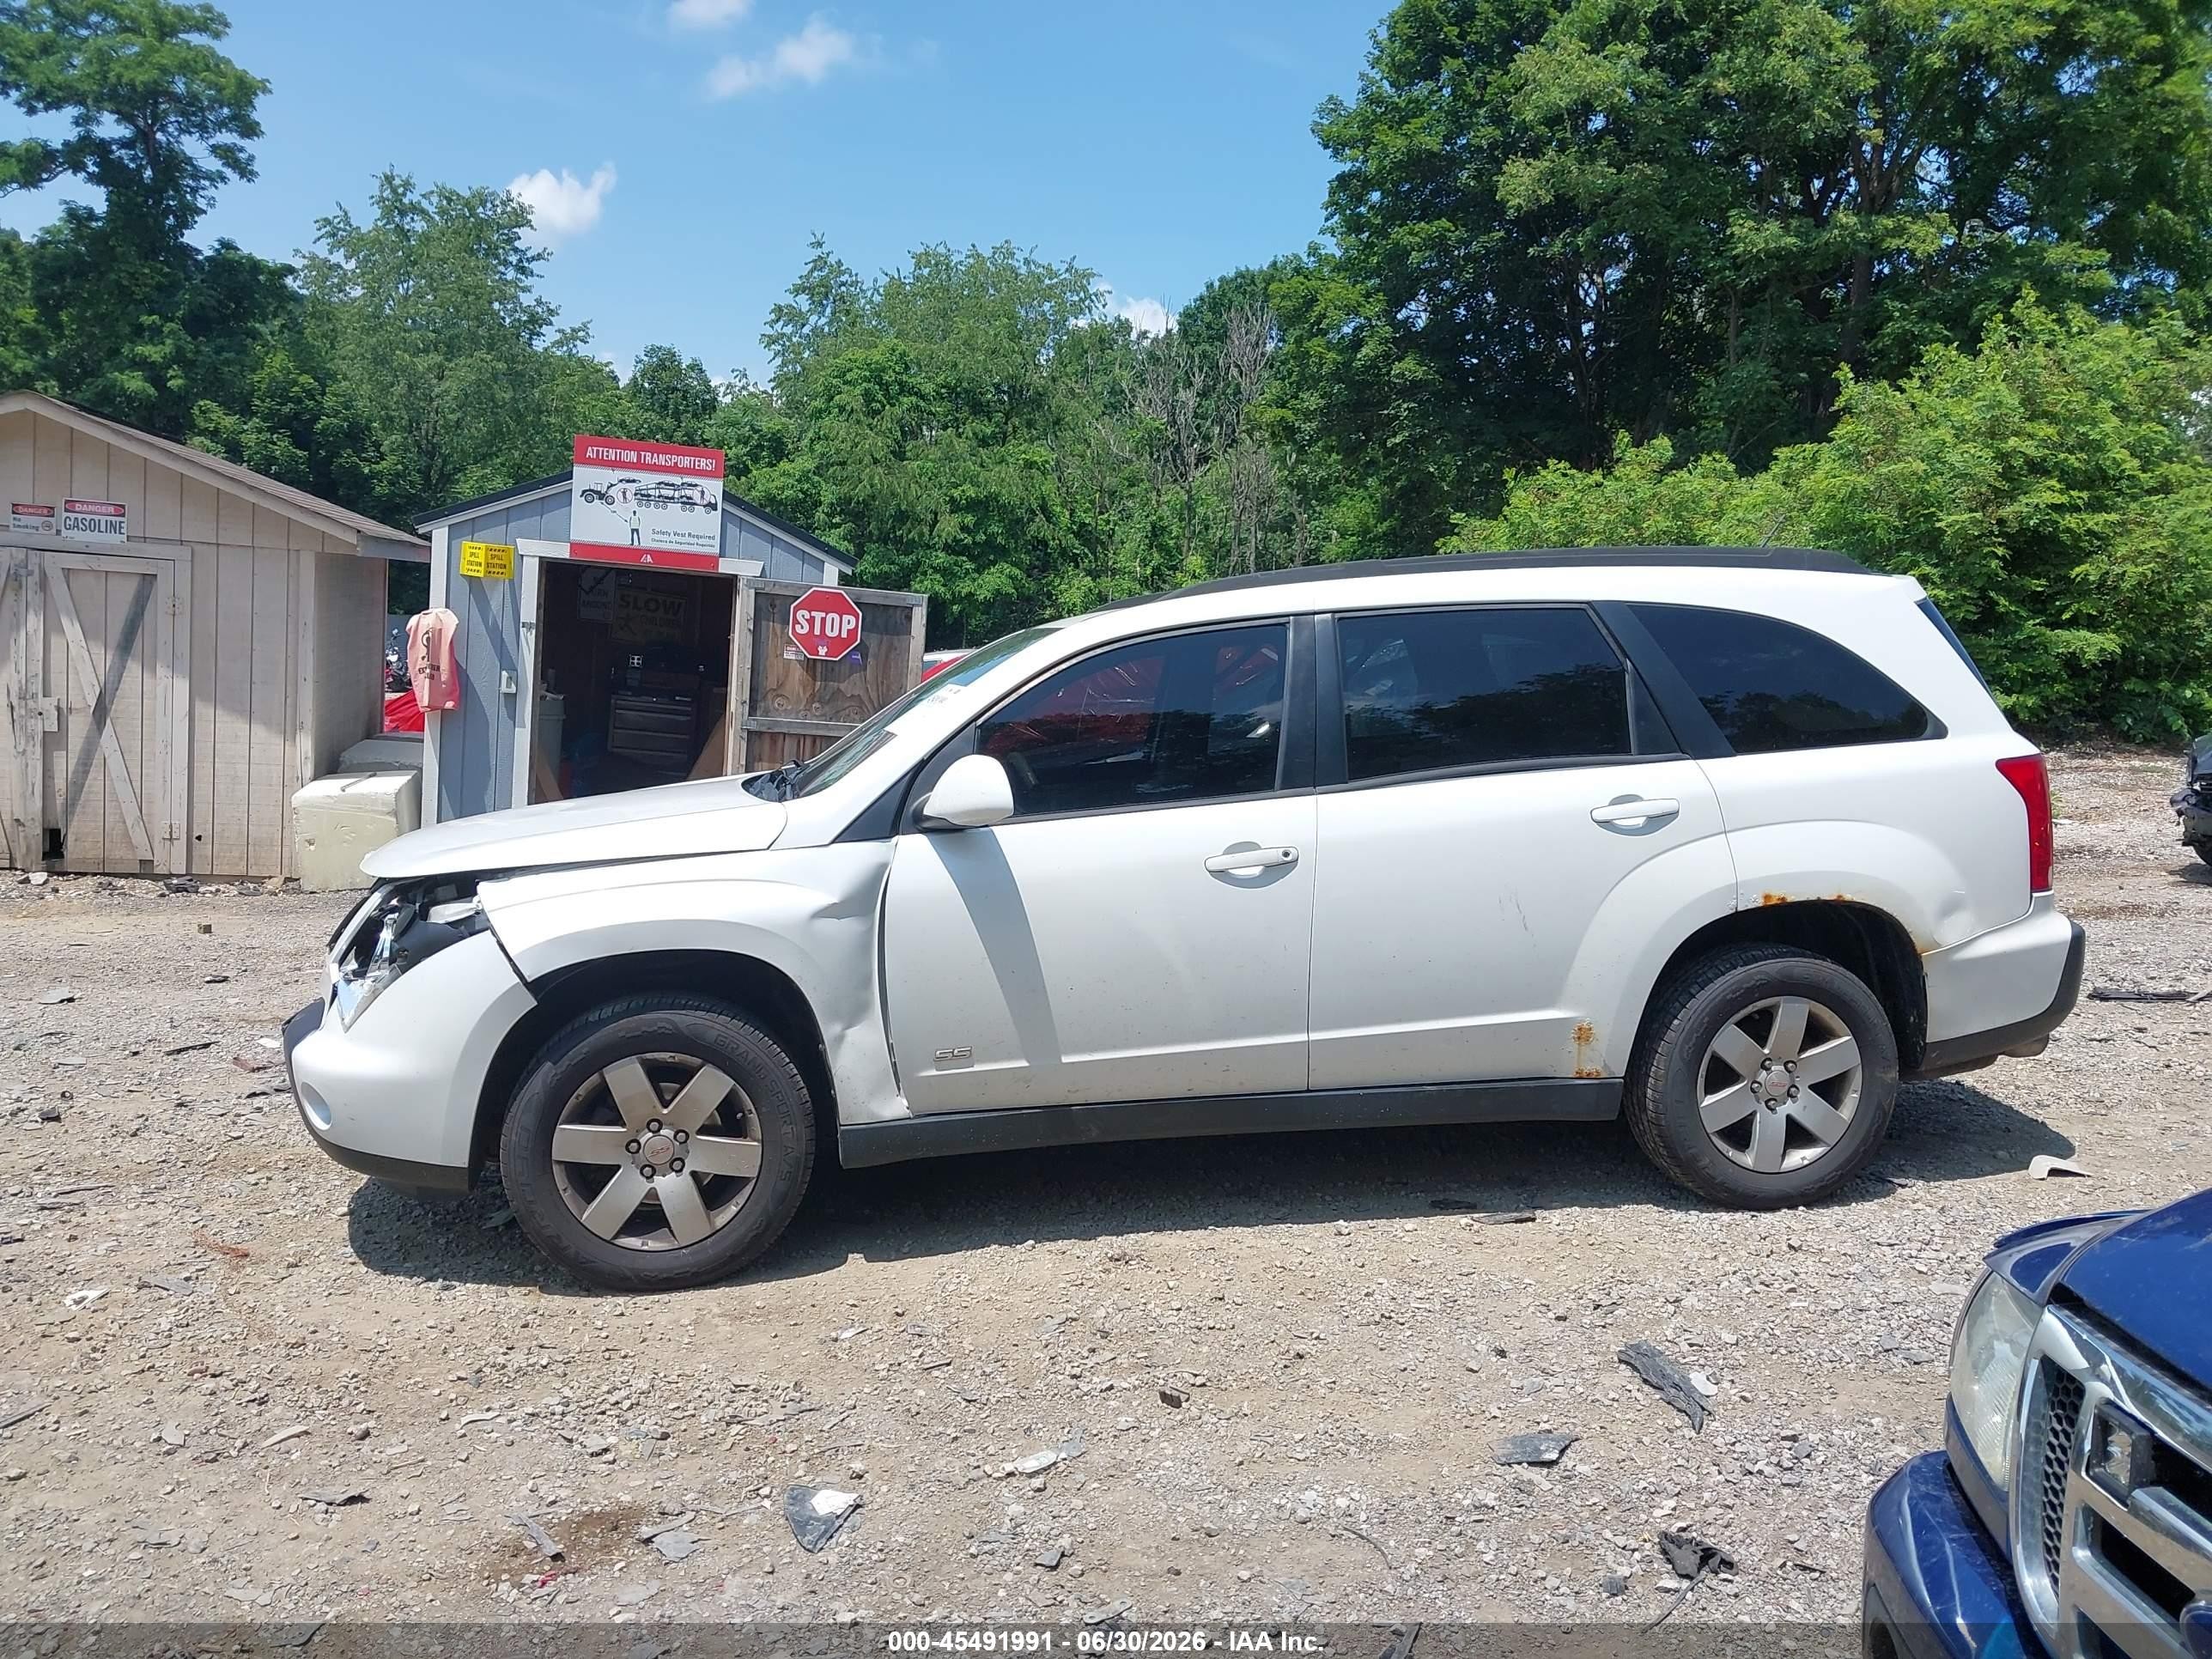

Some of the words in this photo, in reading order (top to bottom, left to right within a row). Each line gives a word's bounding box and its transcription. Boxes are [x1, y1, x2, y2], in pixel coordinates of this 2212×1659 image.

[586, 447, 637, 463] ATTENTION
[640, 452, 715, 471] TRANSPORTERS!
[75, 504, 114, 514] DANGER
[64, 516, 125, 535] GASOLINE
[618, 594, 683, 617] SLOW
[795, 610, 856, 638] STOP
[934, 1047, 972, 1061] SS
